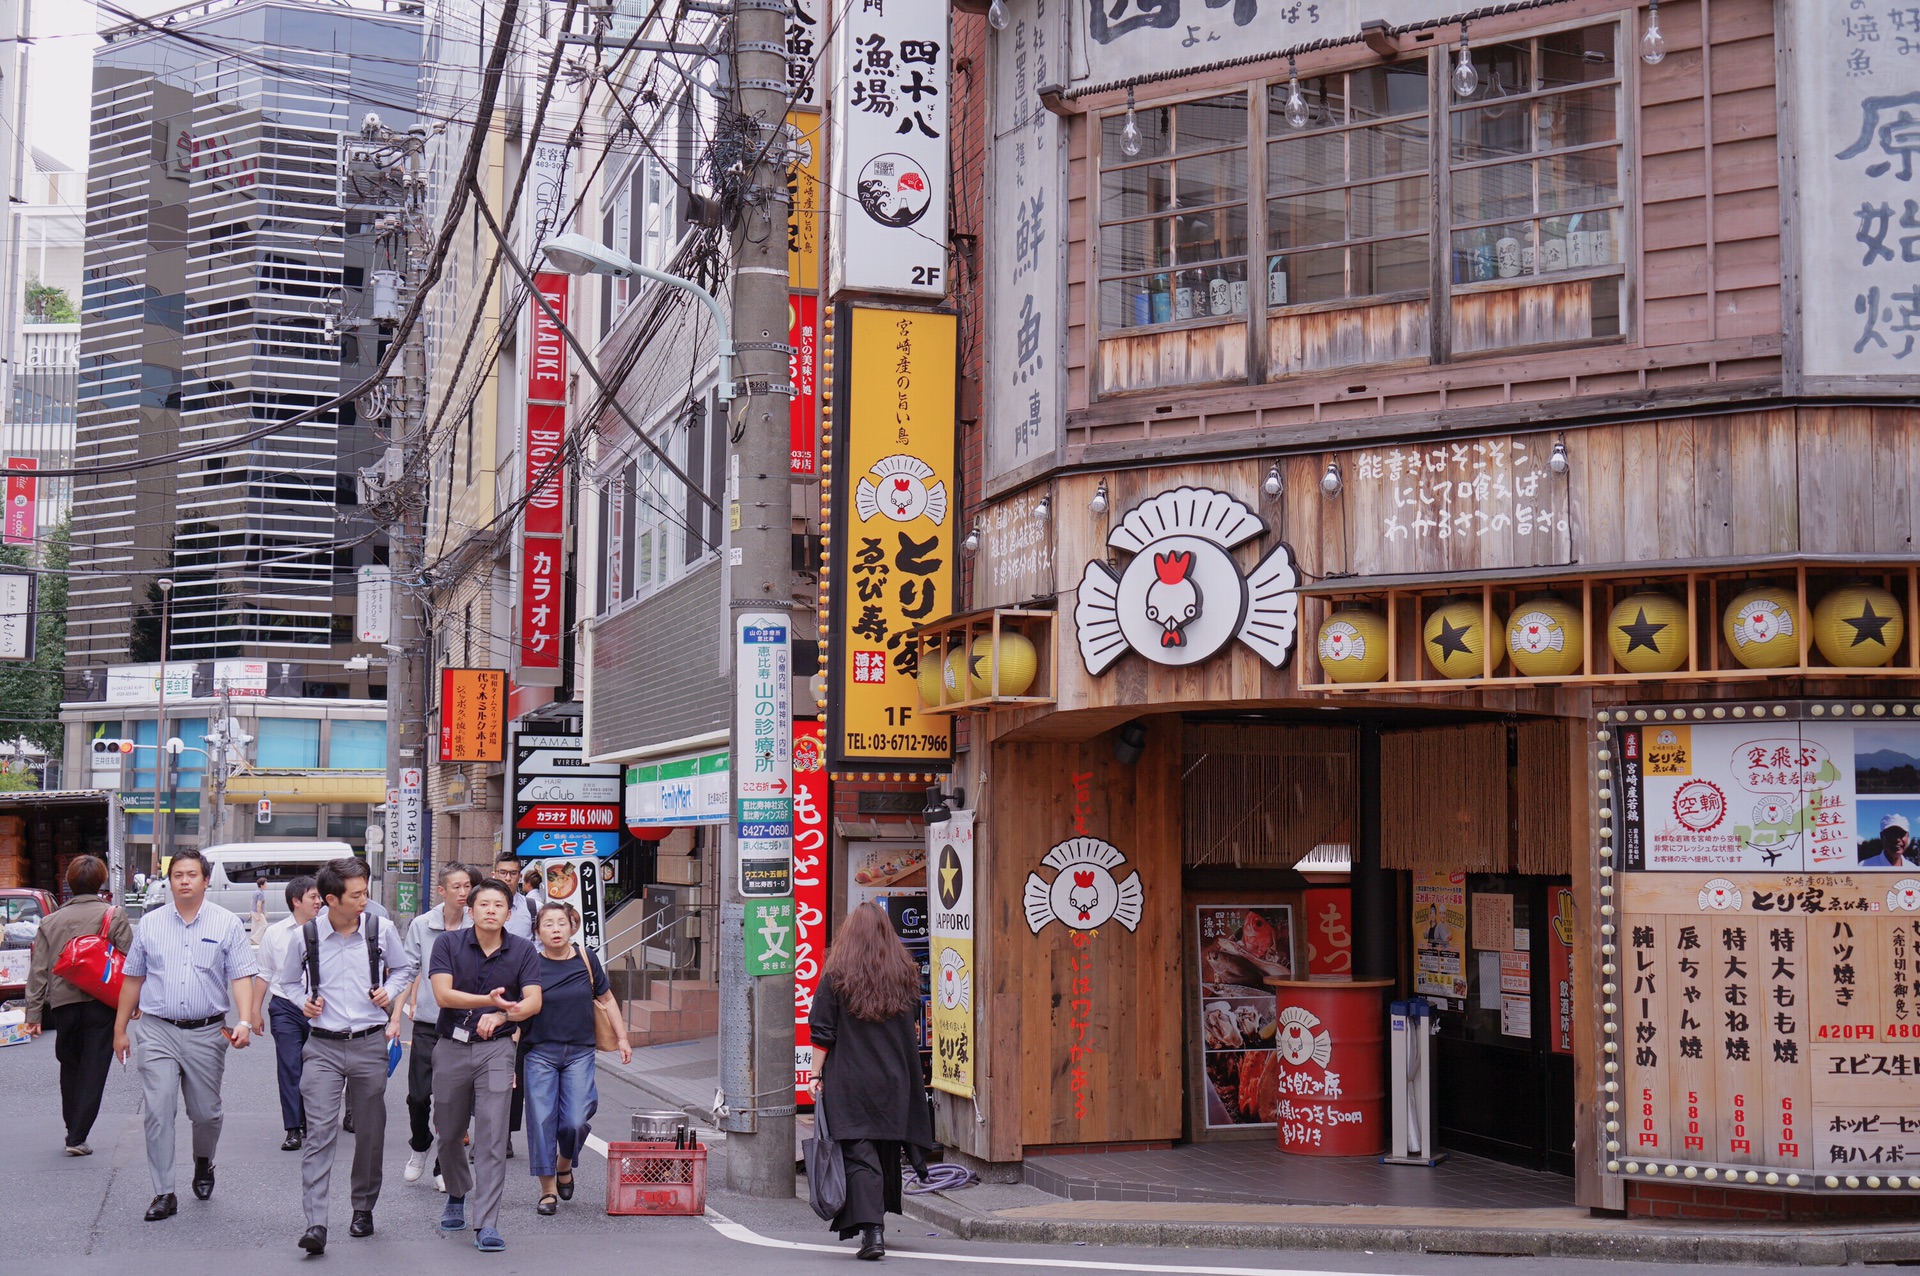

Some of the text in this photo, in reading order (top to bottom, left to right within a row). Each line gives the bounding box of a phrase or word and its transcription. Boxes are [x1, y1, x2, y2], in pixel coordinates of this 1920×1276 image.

[1281, 1, 1320, 24] ぱち
[1181, 25, 1221, 48] よん
[850, 33, 895, 118] 漁場
[895, 40, 941, 139] 四十八
[911, 265, 941, 286] 2F
[1012, 186, 1046, 387] 鮮魚
[536, 292, 561, 382] KARAOKE
[801, 325, 813, 396] 憩いの美味い処
[894, 317, 914, 446] 宮崎産の旨い鳥
[1358, 440, 1529, 482] 能書きはそこそこ
[1394, 470, 1548, 508] にして喰えば
[530, 550, 552, 653] カラオケ
[475, 672, 489, 758] 代々木ミルクホール
[755, 646, 775, 774] 恵比寿 山の診療所
[778, 654, 787, 757] 心療内科・精神科・内科
[884, 706, 912, 727] 1F
[519, 750, 529, 758] 4F
[531, 737, 569, 747] YAMA
[1626, 733, 1637, 757] 産直
[1648, 749, 1687, 764] とり家
[1652, 763, 1677, 773] ゑび寿
[1747, 746, 1817, 769] 空飛ぶ
[743, 782, 770, 792] ここ右折
[1748, 772, 1817, 786] 宮崎産若鶏
[122, 795, 139, 805] SMBC
[1625, 762, 1639, 822] 宮崎産若鶏
[1678, 792, 1721, 817] 空輸
[518, 805, 528, 813] 2F
[537, 812, 568, 822] カラオケ
[570, 808, 614, 825] BIG SOUND
[518, 832, 527, 840] 1F
[742, 824, 790, 837] 6427-0690
[538, 840, 598, 855] 一七三
[1654, 855, 1743, 863] お客様の元へ提供しています
[1783, 876, 1854, 887] 宮崎産の旨い鳥
[756, 905, 791, 918] 通学路
[1752, 887, 1869, 914] とり家 ゑび寿
[1204, 917, 1215, 938] 漁場
[1216, 911, 1226, 936] 四十八
[757, 925, 790, 962] 文
[762, 961, 787, 970] 渋谷区
[1502, 954, 1517, 962] ENGLISH
[1502, 961, 1522, 969] AVAILABLE
[1832, 921, 1856, 1008] ハツ焼き
[1677, 925, 1703, 1059] 辰ちゃん焼
[1722, 927, 1751, 1062] 特大むね焼
[1769, 927, 1799, 1064] 特大もも焼
[1559, 980, 1571, 1050] 飲酒防止
[1818, 1023, 1875, 1040] 420円
[938, 1032, 969, 1065] とり家
[1278, 1065, 1343, 1100] 立ち飲み席
[1639, 1088, 1658, 1147] 580円
[1684, 1091, 1704, 1151] 580円
[1730, 1094, 1750, 1154] 680円
[1778, 1097, 1799, 1158] 680円
